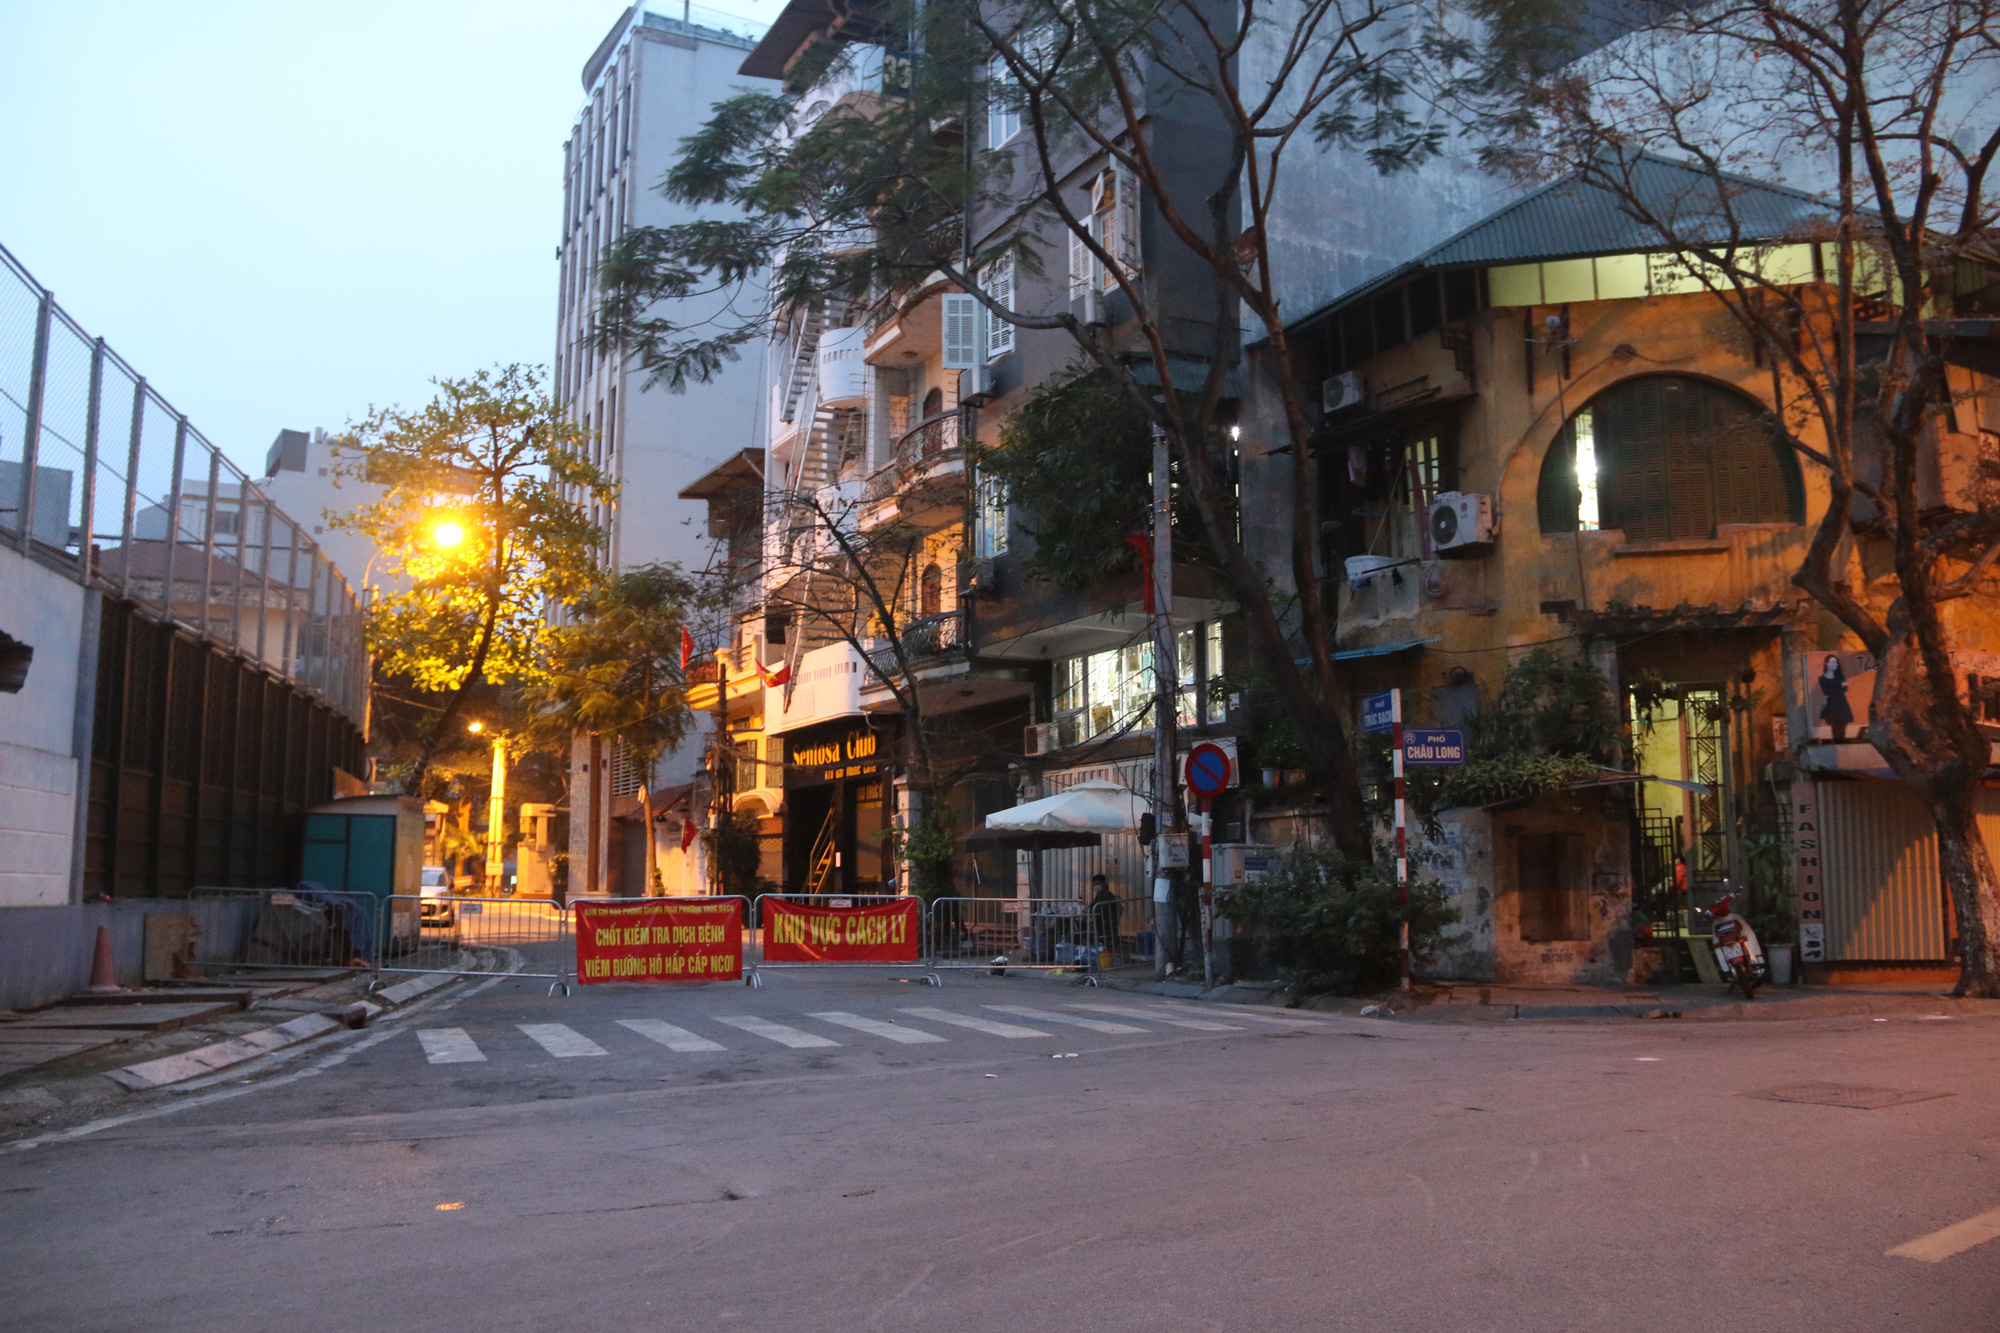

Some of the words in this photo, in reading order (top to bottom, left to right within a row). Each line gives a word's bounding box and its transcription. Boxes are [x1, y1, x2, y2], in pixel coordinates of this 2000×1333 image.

[793, 742, 840, 766] Sentosa
[846, 728, 876, 760] Club
[1408, 744, 1433, 759] CHÂU
[1436, 746, 1460, 759] LONG
[1428, 734, 1446, 742] PHỐ
[1799, 804, 1821, 919] FASHION
[596, 922, 620, 946] CHỐT
[624, 921, 649, 946] KIỂM
[652, 926, 670, 945] TRA
[673, 926, 695, 947] DỊCH
[698, 922, 725, 946] BỆNH
[774, 913, 805, 944] KHU
[810, 913, 840, 952] VỰC
[846, 911, 886, 945] CÁCH
[891, 914, 907, 943] LY
[585, 956, 610, 977] VIÊM
[613, 954, 646, 976] ĐƯỜNG
[650, 953, 662, 974] HÔ
[665, 950, 685, 974] HẤP
[688, 949, 707, 974] CẤP
